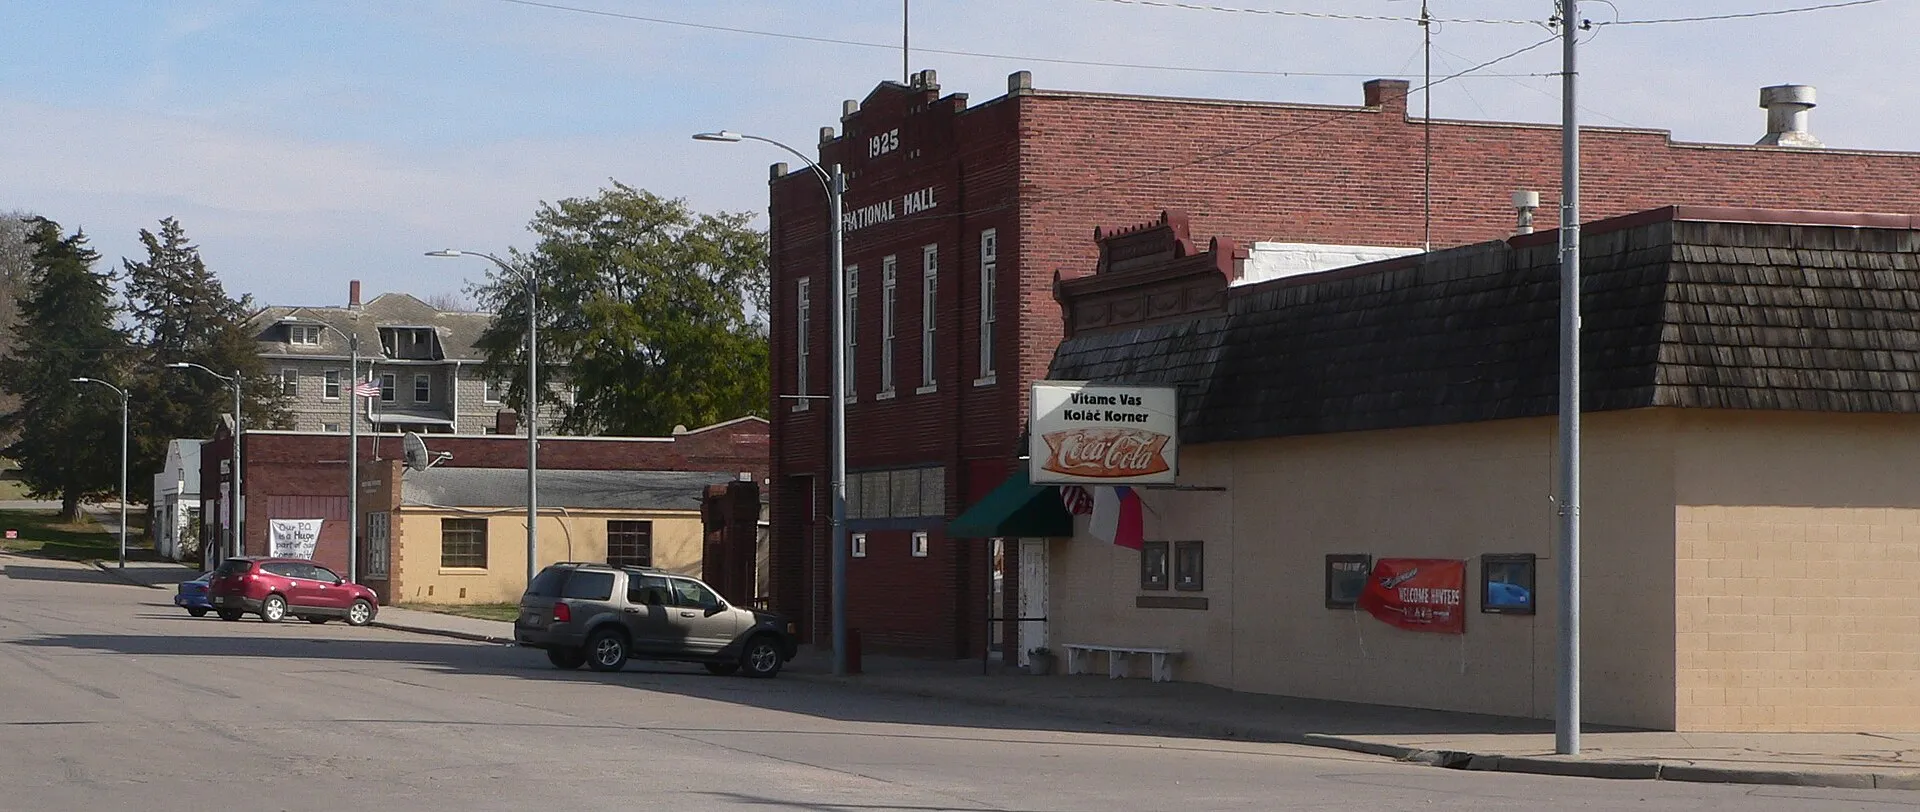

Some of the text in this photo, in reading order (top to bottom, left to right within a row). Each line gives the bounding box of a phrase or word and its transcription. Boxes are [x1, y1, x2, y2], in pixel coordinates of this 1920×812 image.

[869, 128, 899, 158] 1925
[843, 187, 937, 233] NATIONAL HALL
[1071, 393, 1142, 406] Vitame Vas
[1105, 410, 1149, 423] Korner
[279, 523, 296, 531] Our
[294, 530, 315, 542] Huge
[276, 541, 293, 550] part
[1398, 587, 1460, 606] WELCOME HUNTERS
